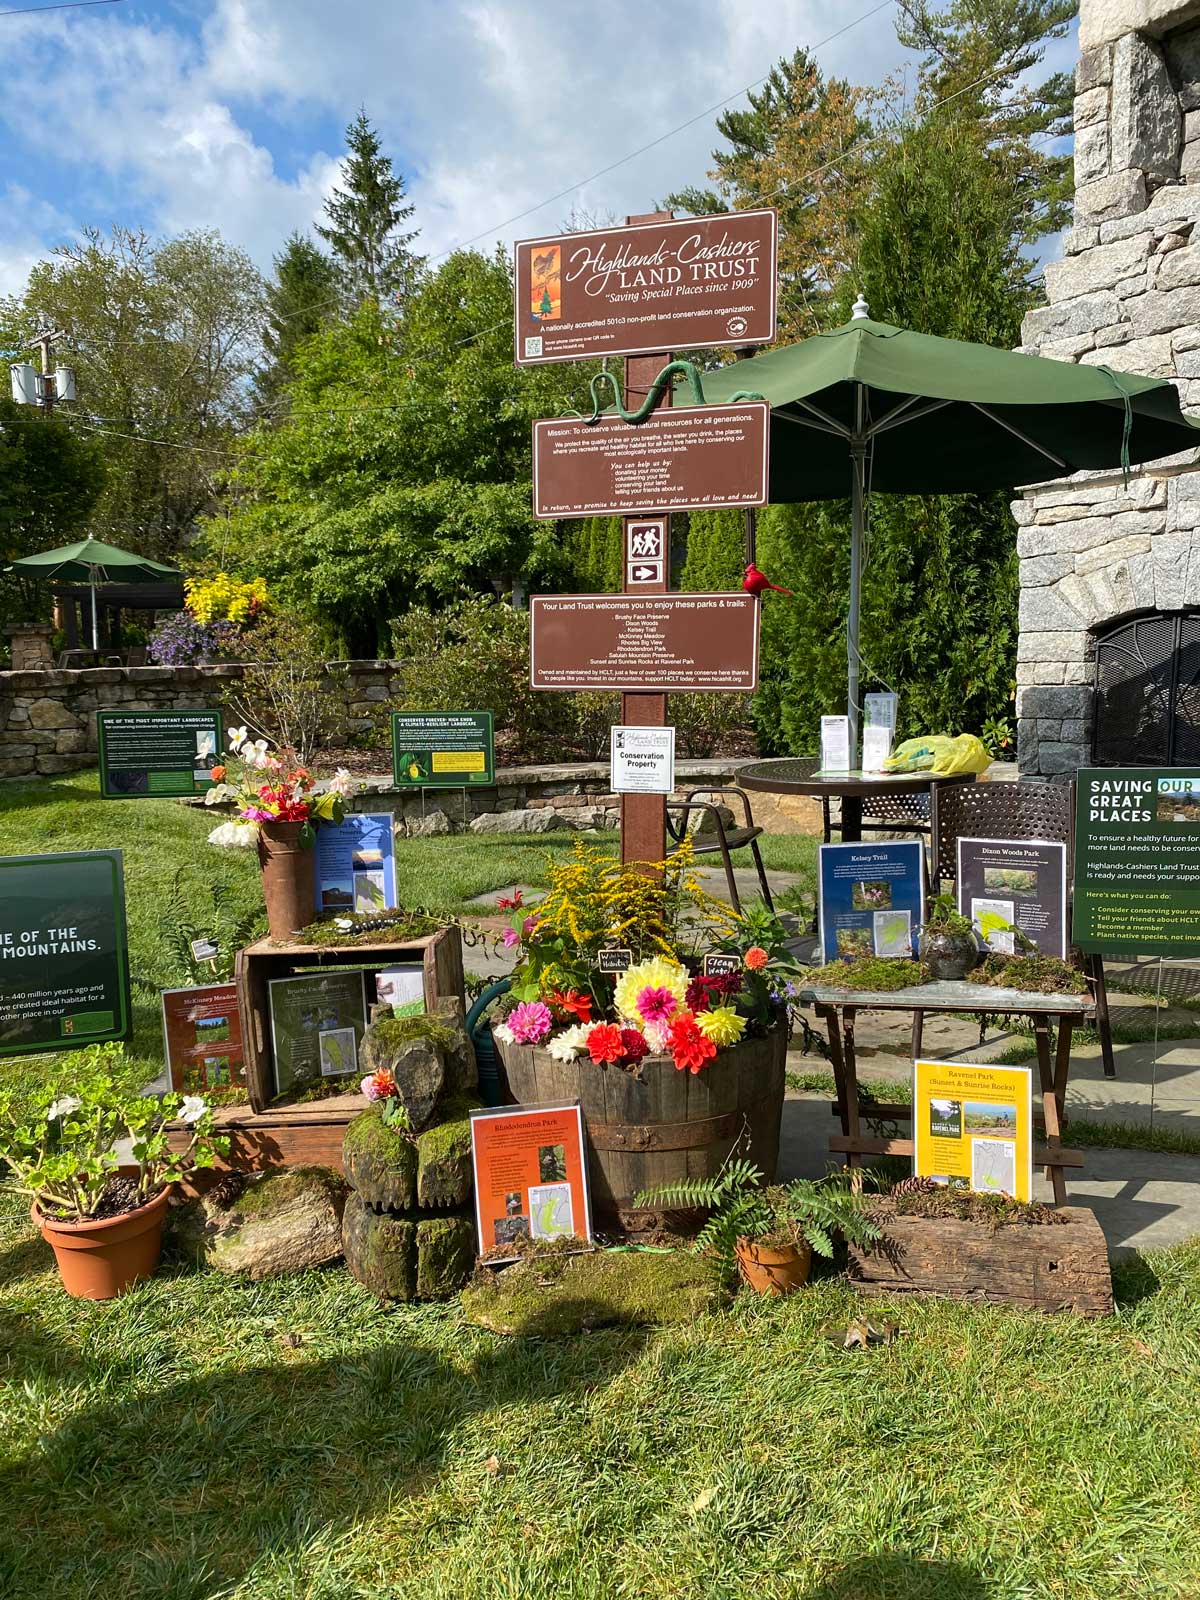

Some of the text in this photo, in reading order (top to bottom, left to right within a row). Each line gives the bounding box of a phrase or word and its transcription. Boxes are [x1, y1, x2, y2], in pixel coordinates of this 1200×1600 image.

[566, 232, 760, 296] Highlands-Cashiers
[619, 258, 759, 289] LAND TRUST
[642, 288, 673, 300] Special
[676, 286, 702, 295] Places
[706, 284, 728, 292] since
[546, 323, 574, 332] nationally
[575, 318, 605, 329] accredited
[607, 317, 625, 325] 501c3
[627, 314, 656, 323] non-profit
[672, 309, 713, 318] conservation
[714, 305, 756, 315] organization.
[661, 419, 692, 427] resources
[714, 415, 754, 424] generations.
[697, 600, 717, 609] parks
[628, 760, 656, 768] Property
[1091, 781, 1192, 792] SAVING OUR
[1090, 796, 1143, 807] GREAT
[1090, 810, 1151, 822] PLACES
[1134, 835, 1161, 843] healthy
[1094, 872, 1115, 880] ready
[20, 931, 39, 942] OF
[48, 927, 77, 940] THE
[3, 940, 101, 959] MOUNTAINS.
[708, 958, 733, 967] Clean
[54, 988, 73, 997] years
[12, 1001, 40, 1010] created
[42, 998, 59, 1006] ideal
[61, 996, 86, 1004] habitat
[23, 1011, 41, 1019] place
[948, 1071, 976, 1079] Ravenel
